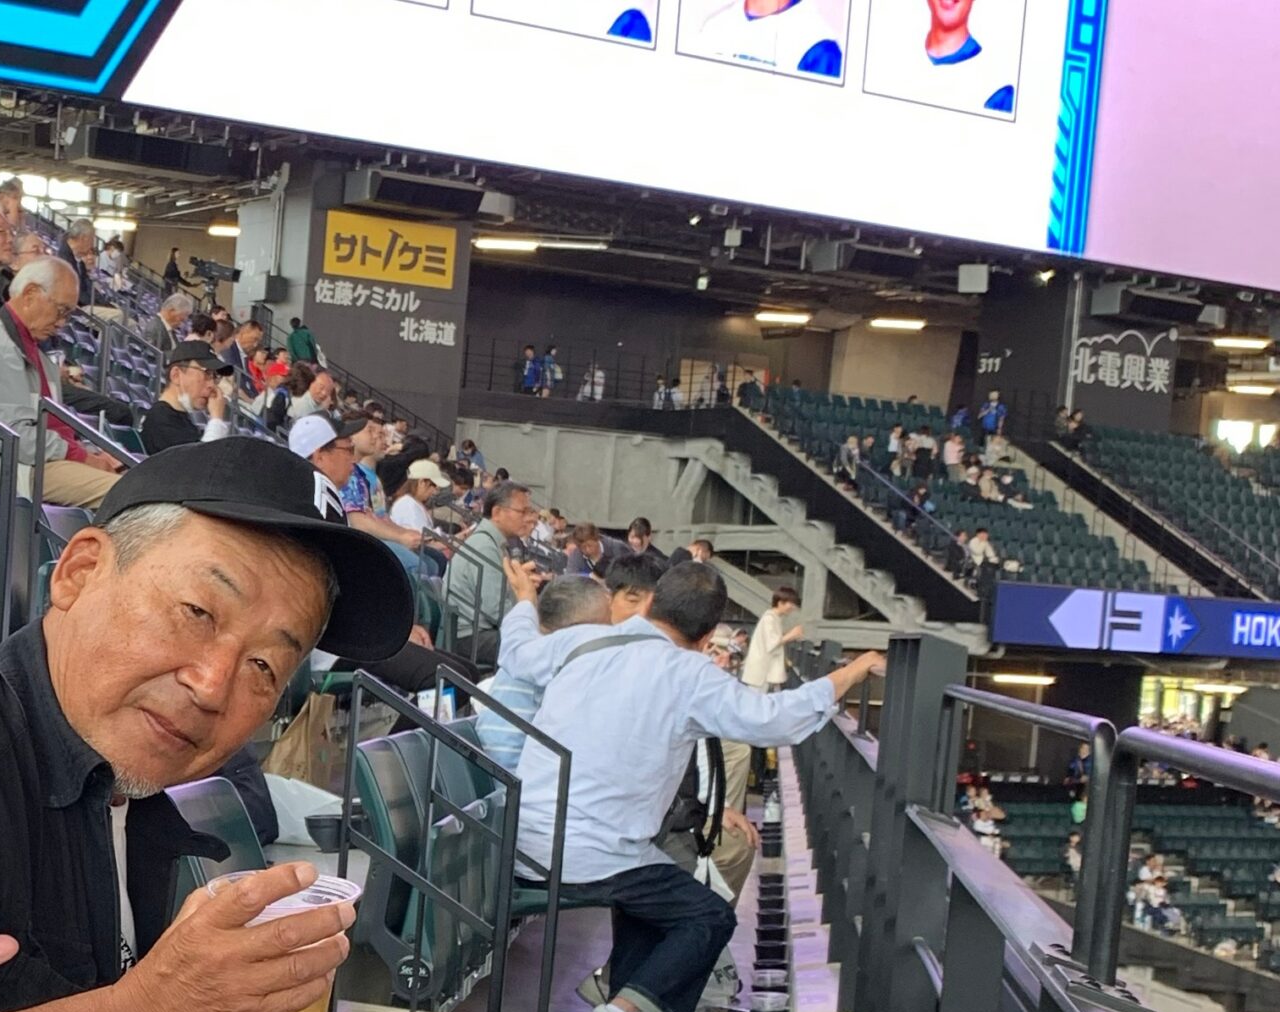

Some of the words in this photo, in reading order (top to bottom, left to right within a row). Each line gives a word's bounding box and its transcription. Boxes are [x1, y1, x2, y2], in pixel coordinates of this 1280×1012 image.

[314, 278, 421, 313] 佐藤ケミカル
[399, 317, 456, 346] 北海道
[977, 357, 1001, 374] 311
[1072, 347, 1170, 394] 北電興業
